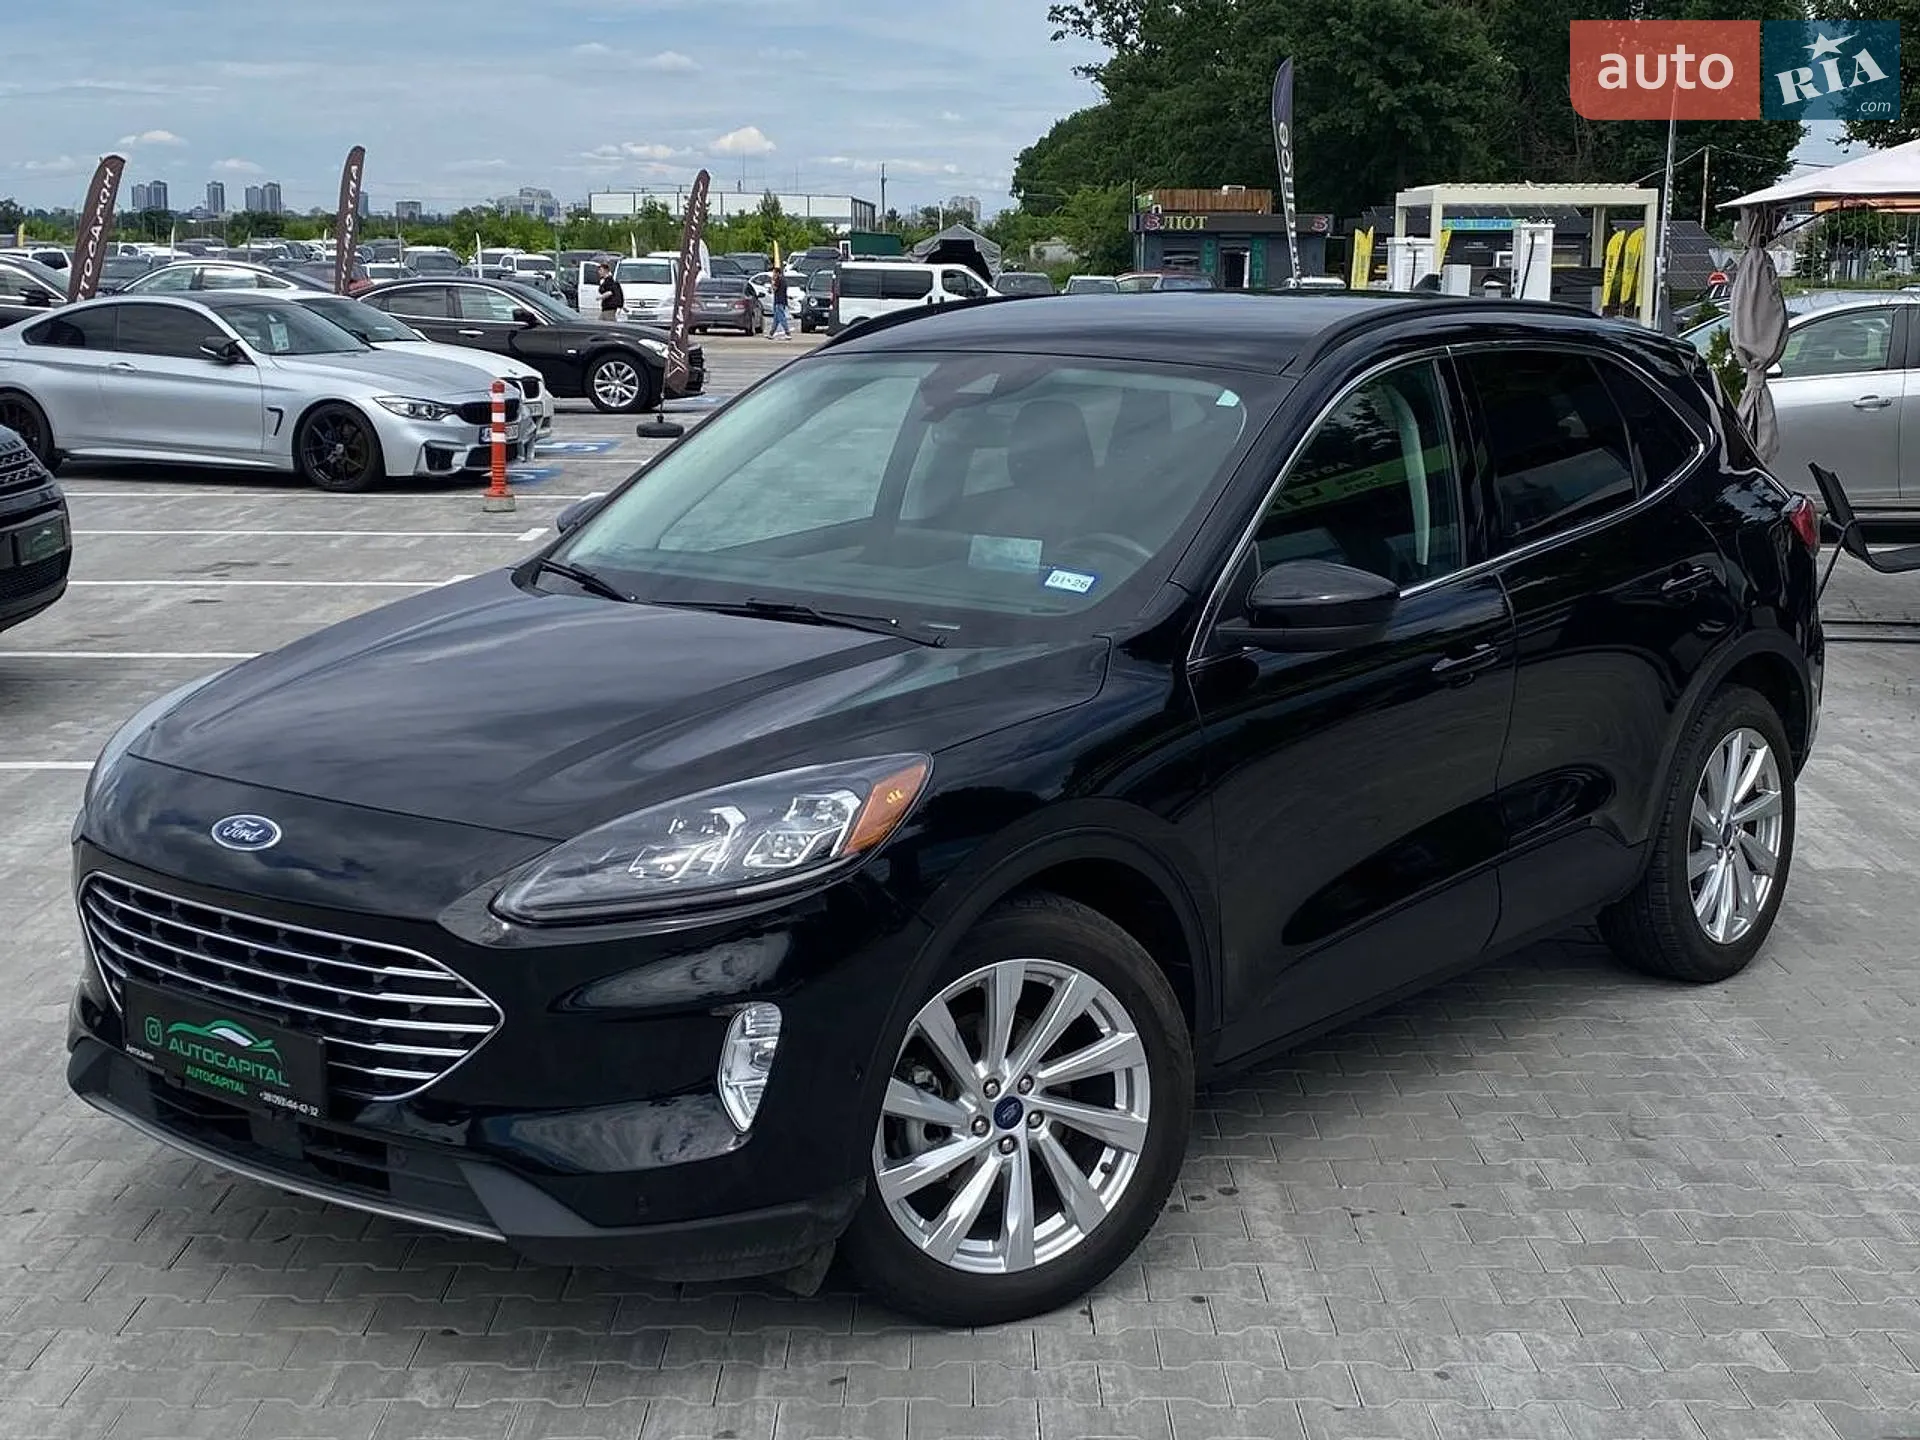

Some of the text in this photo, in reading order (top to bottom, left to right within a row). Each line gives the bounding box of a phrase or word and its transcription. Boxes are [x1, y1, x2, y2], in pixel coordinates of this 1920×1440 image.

[222, 819, 265, 841] Ford
[168, 1037, 290, 1087] AUTOCAPITAL
[185, 1064, 248, 1096] AUTOCAPITAL
